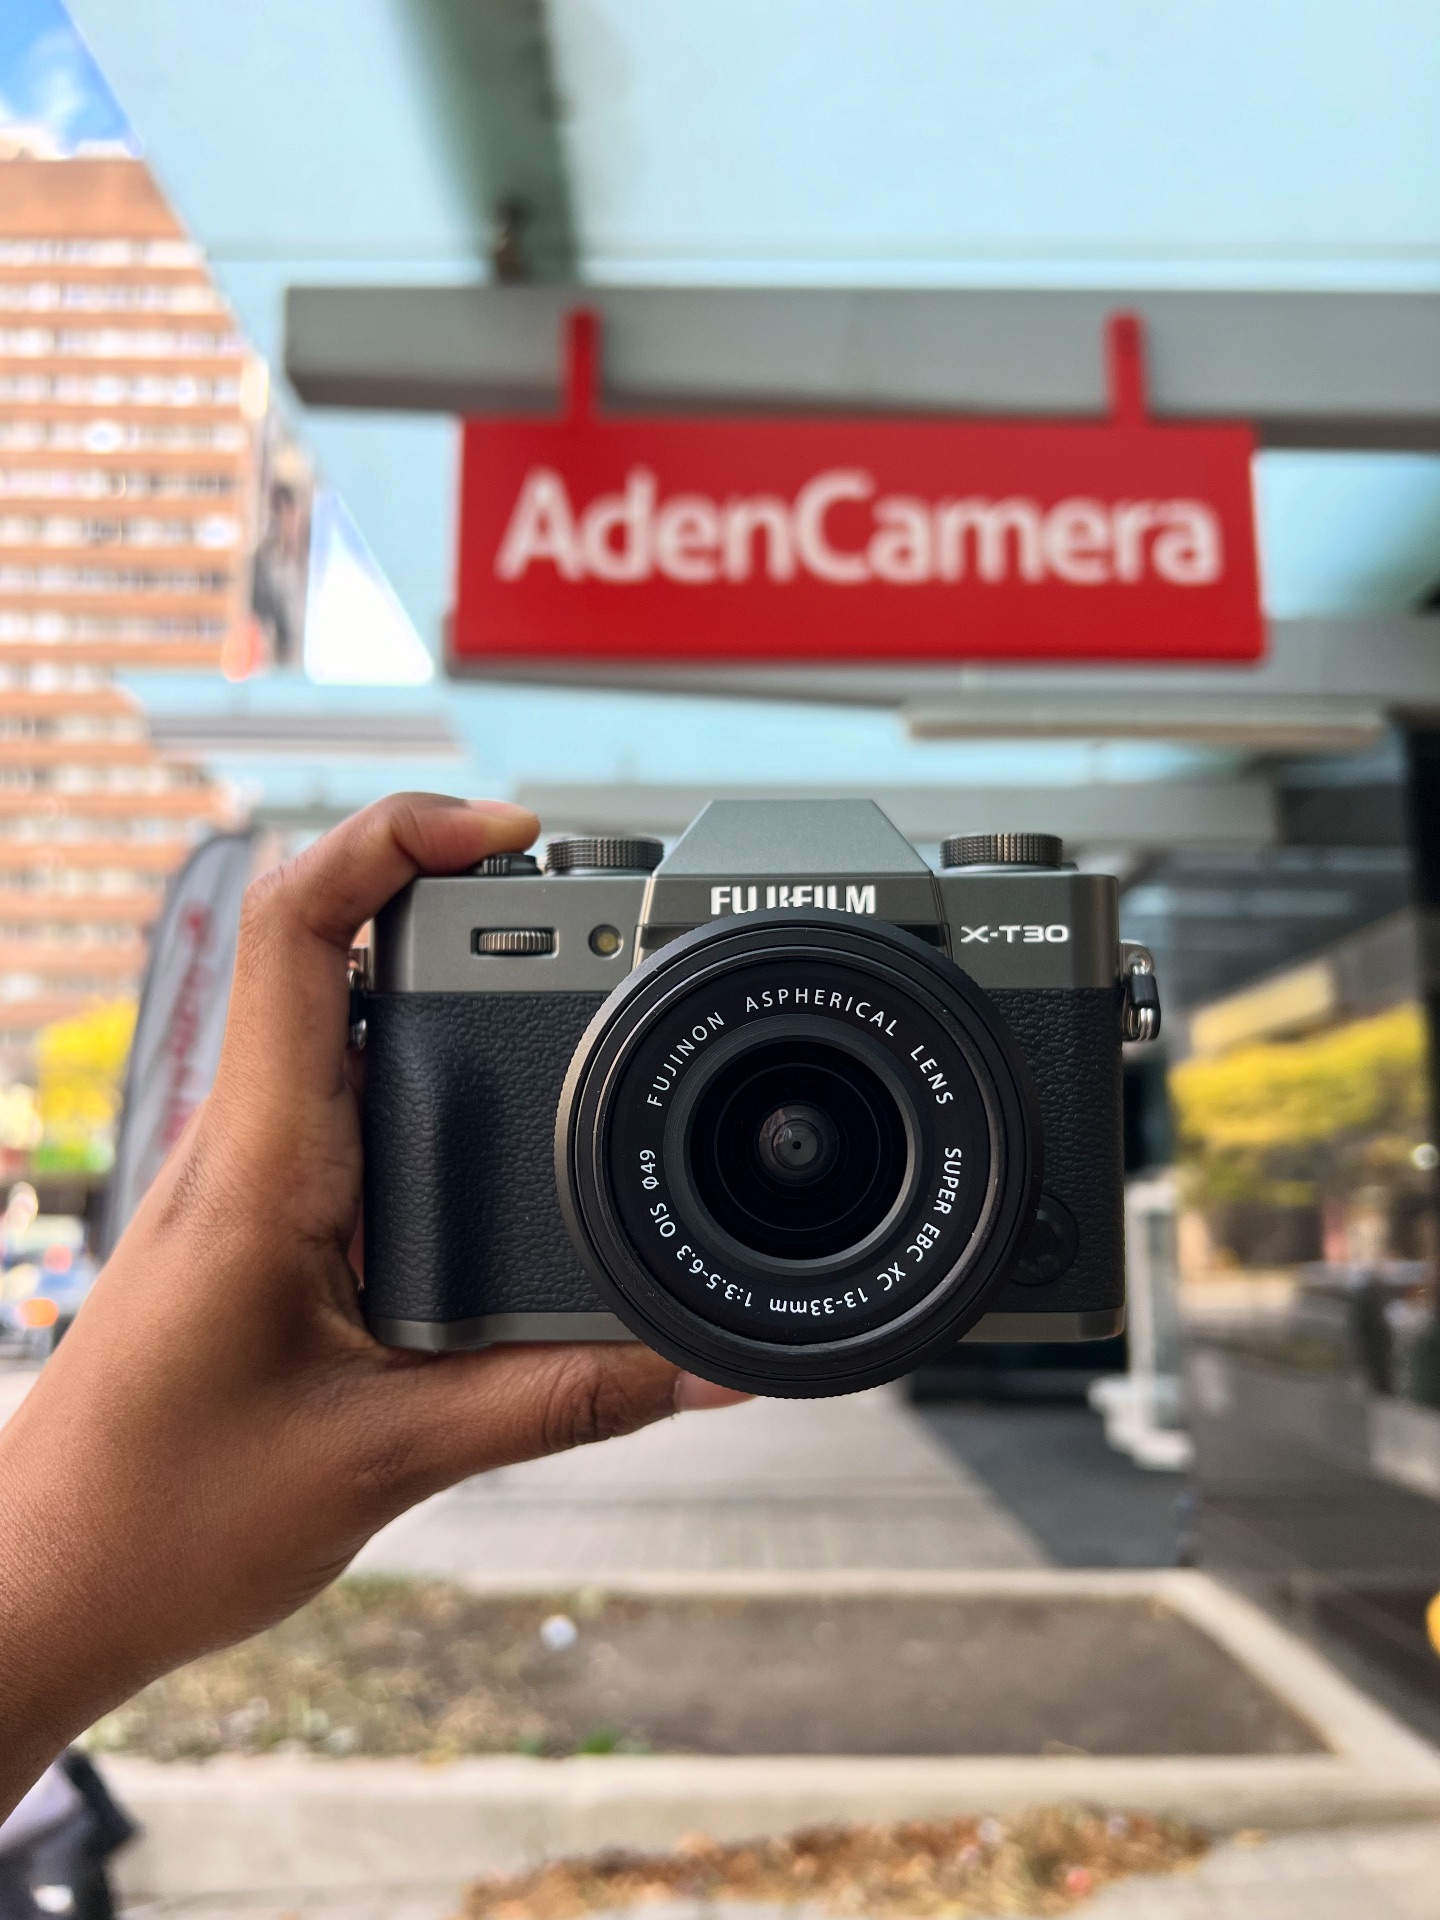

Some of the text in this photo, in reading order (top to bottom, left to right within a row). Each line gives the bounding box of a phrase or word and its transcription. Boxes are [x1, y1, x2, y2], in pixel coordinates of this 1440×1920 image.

[496, 468, 1222, 584] AdenCamera
[960, 924, 1070, 944] X-T30
[646, 987, 954, 1107] FUJINON ASPHERICAL LENS
[933, 1147, 962, 1215] SUPER
[649, 1202, 676, 1238] OIS
[906, 1222, 940, 1262] EBC
[676, 1244, 752, 1307] 1:3.5-6.3
[876, 1262, 906, 1291] XC
[769, 1287, 869, 1316] 13-33mm
